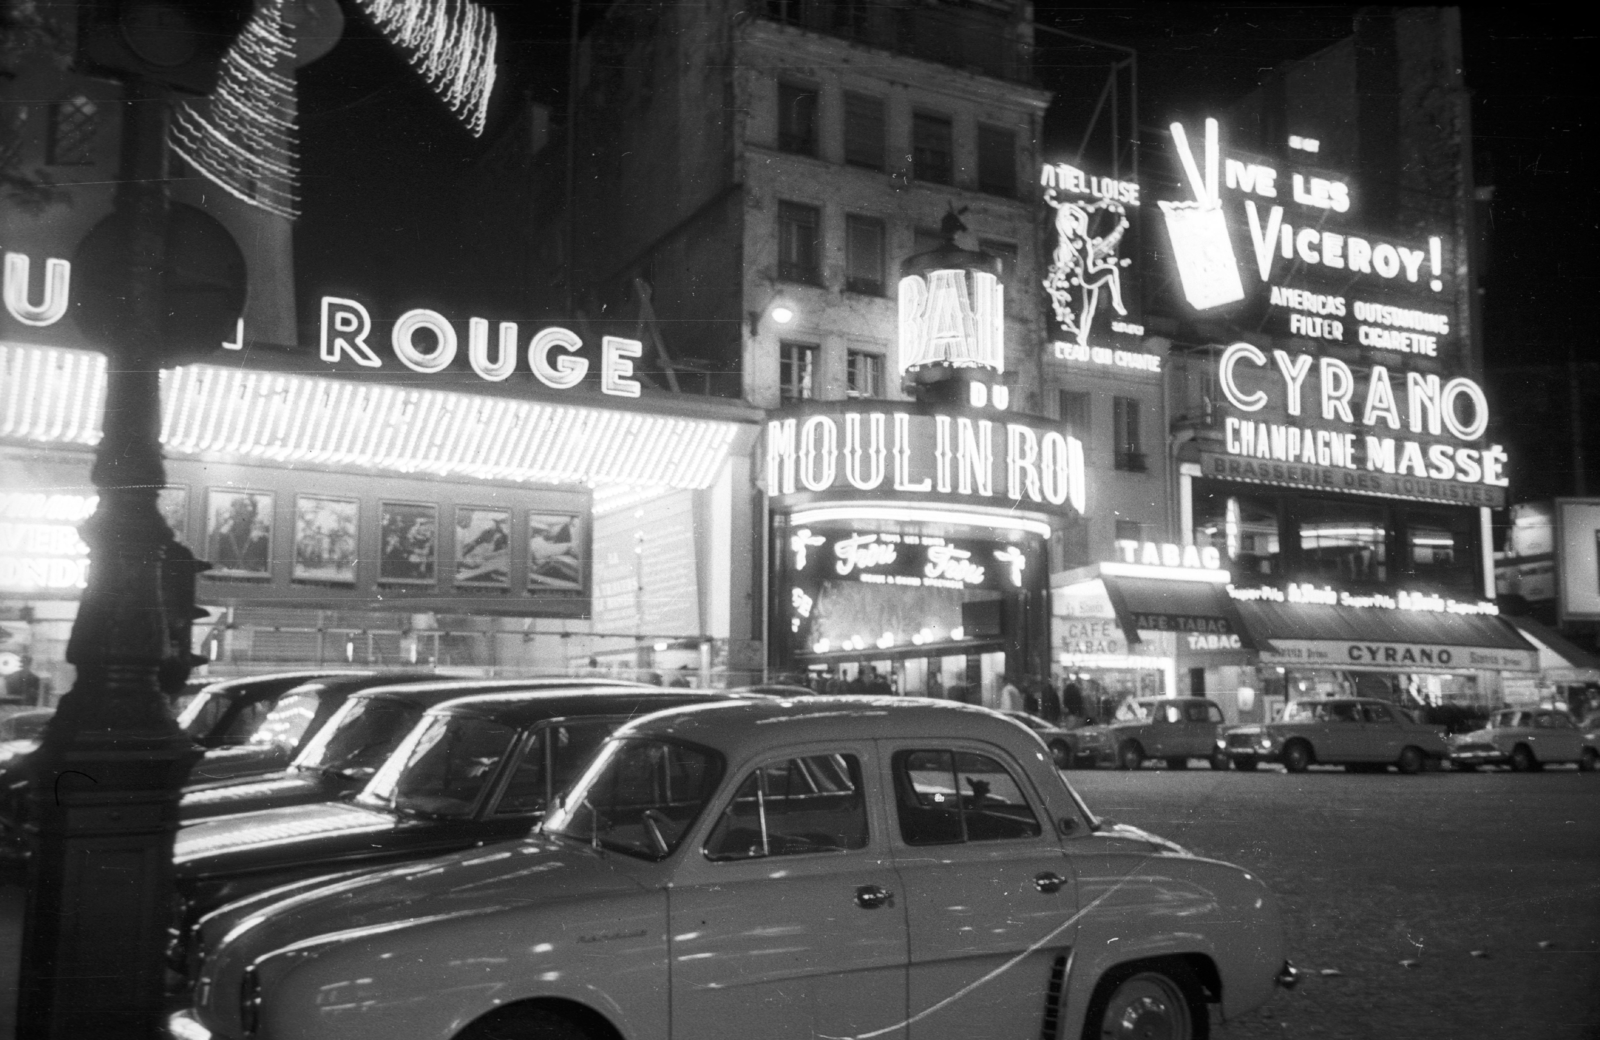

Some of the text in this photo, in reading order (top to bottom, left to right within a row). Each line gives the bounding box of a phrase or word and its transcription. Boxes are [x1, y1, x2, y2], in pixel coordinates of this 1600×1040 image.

[1293, 174, 1349, 212] LES
[1245, 200, 1442, 292] VICEROY!
[1291, 314, 1439, 356] FILTER CIGARETTE
[1354, 301, 1449, 335] OUTSTANDING
[320, 296, 643, 398] ROUGE
[970, 380, 1009, 410] DU
[1219, 342, 1489, 441] CYRANO
[767, 413, 993, 497] MOULIN
[1226, 417, 1357, 470] CHAMPAGNE
[1214, 458, 1494, 503] BRASSERIE DES TOURISTES
[1120, 539, 1221, 570] TABAC
[1188, 632, 1241, 649] TABAC
[1348, 645, 1452, 664] CYRANO
